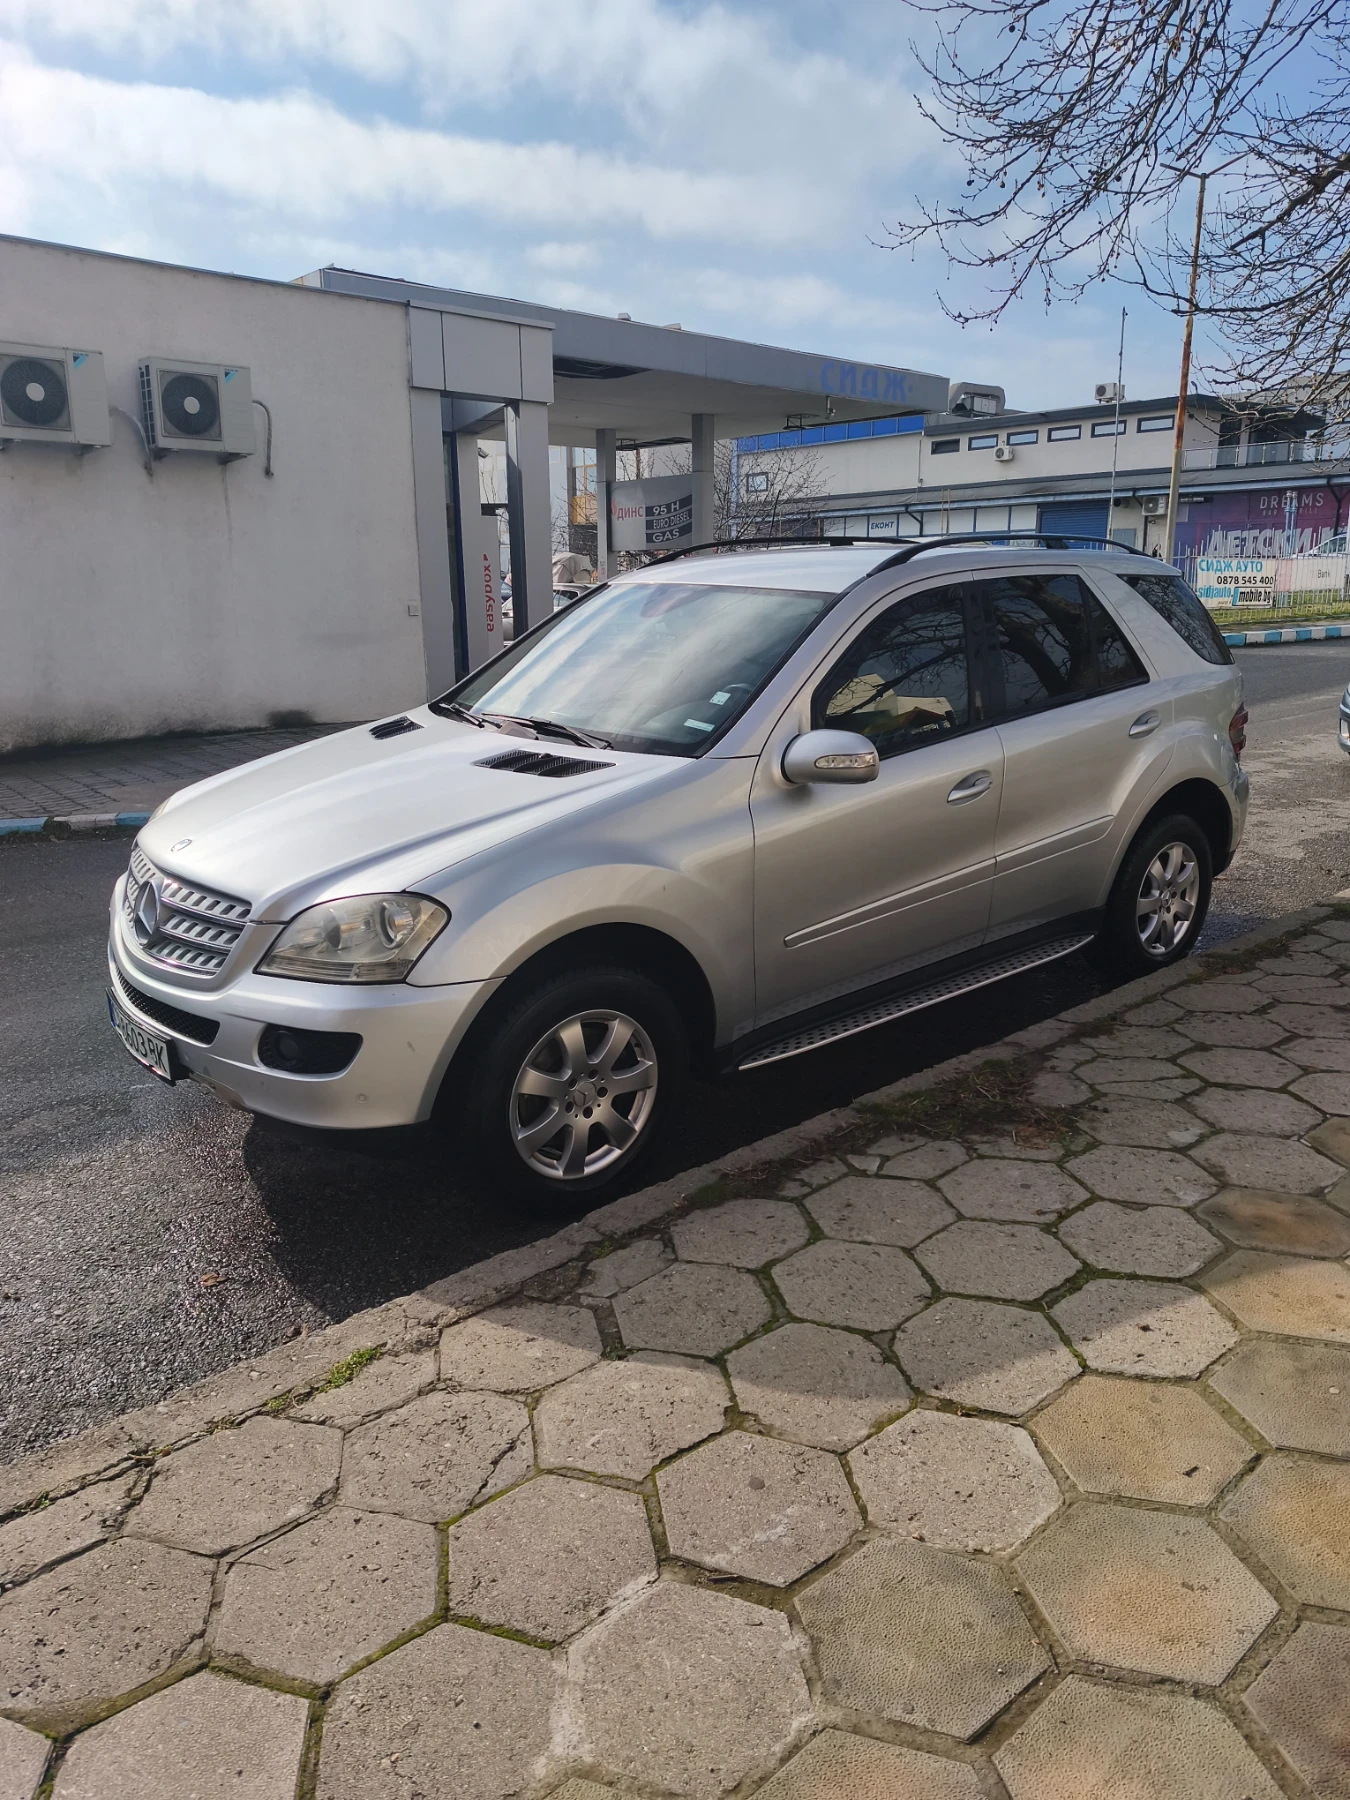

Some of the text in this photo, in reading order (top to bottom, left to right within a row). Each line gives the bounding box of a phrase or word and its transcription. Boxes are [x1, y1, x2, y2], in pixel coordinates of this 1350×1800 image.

[821, 360, 907, 403] СИДЖ
[1259, 492, 1324, 509] DREAMS
[652, 505, 667, 516] 95
[653, 511, 690, 530] EURO DIESEL
[870, 521, 895, 530] ЕКОНТ
[652, 528, 680, 542] GAS
[1198, 559, 1263, 574] СИДЖ АУТО
[1216, 575, 1274, 585] 0878 545 400
[1238, 588, 1271, 604] mobile.bg
